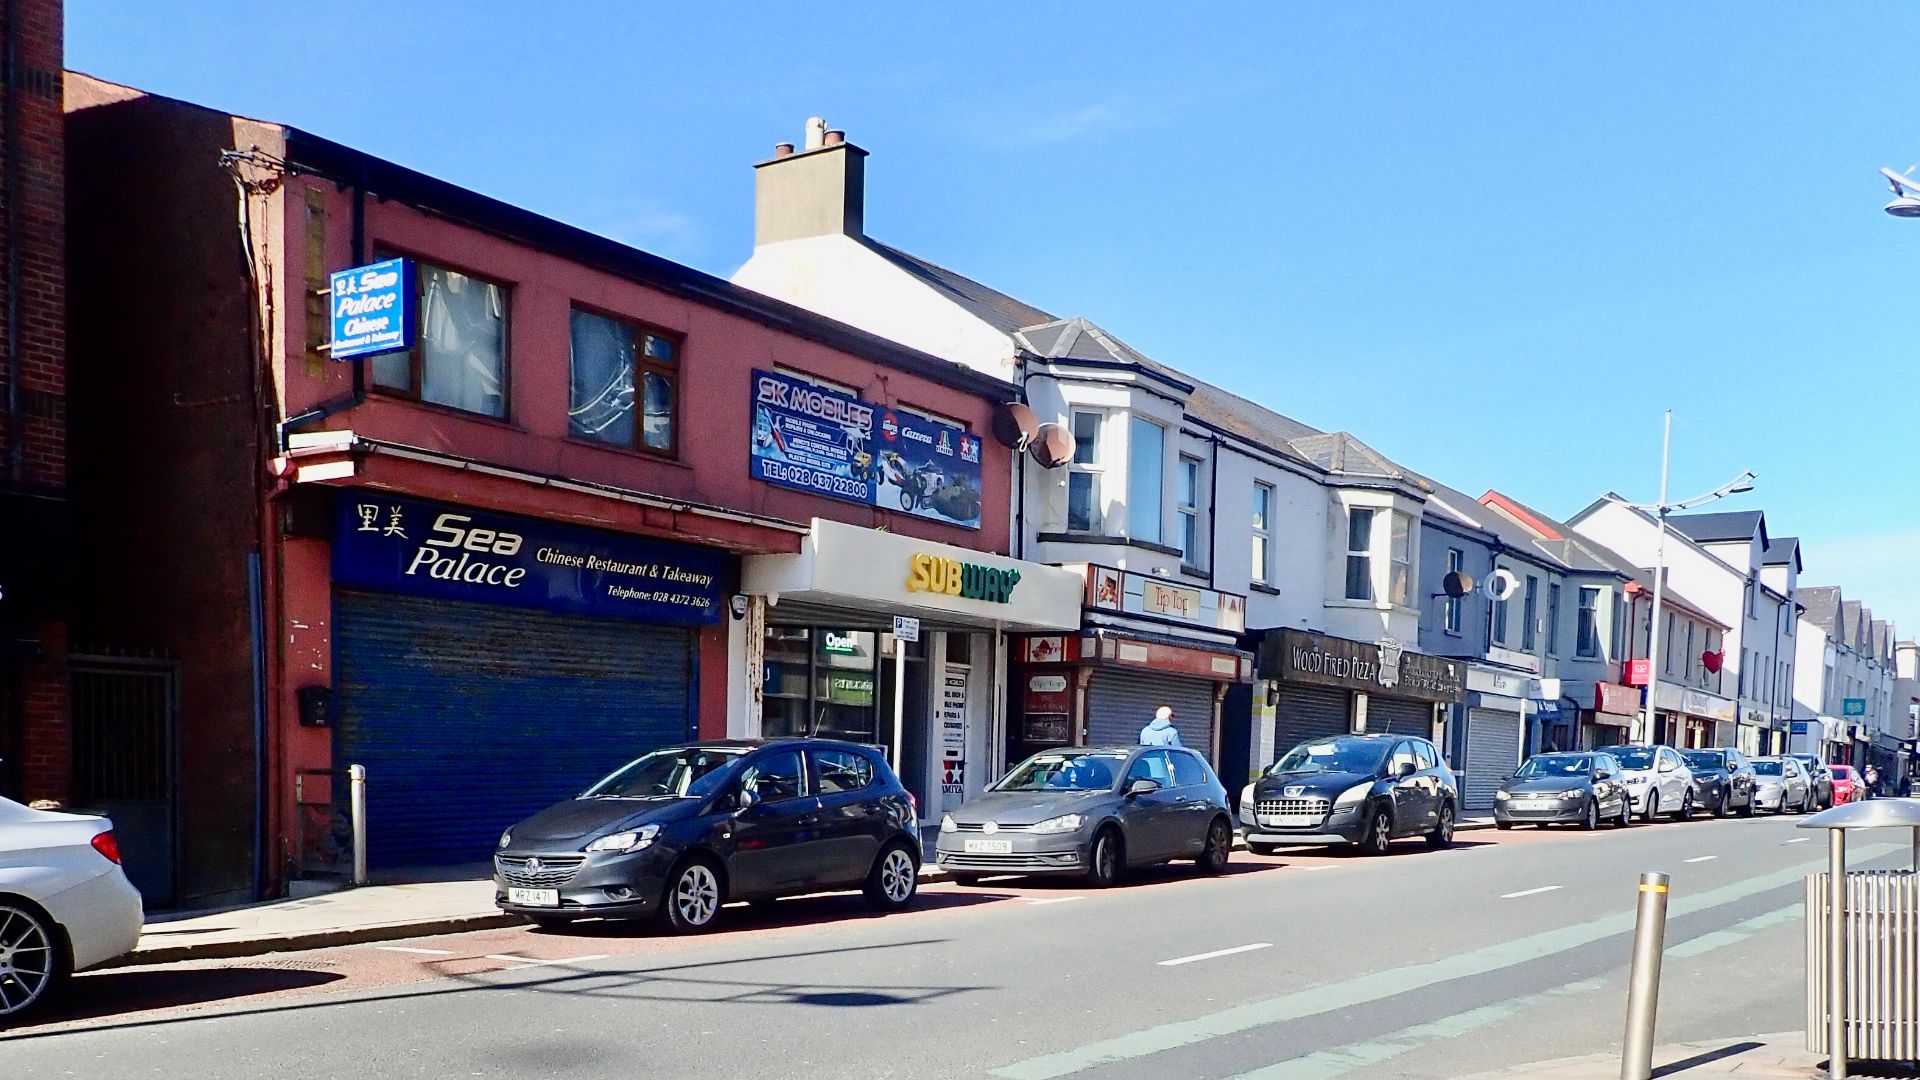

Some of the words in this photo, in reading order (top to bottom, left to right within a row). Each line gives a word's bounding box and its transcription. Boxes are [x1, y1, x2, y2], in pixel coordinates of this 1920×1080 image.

[359, 272, 398, 292] Sea
[336, 293, 396, 318] Palace
[757, 377, 789, 409] SK
[789, 386, 874, 431] MOBILES
[902, 427, 933, 444] Carrera
[426, 513, 524, 556] Sea
[405, 547, 526, 588] Palace
[536, 547, 584, 568] Chinese
[586, 555, 648, 577] Restaurant
[649, 564, 659, 579] &
[661, 565, 713, 590] Takeaway
[905, 553, 1021, 604] SUBWAY
[608, 585, 651, 602] Telephone:
[653, 591, 669, 603] 028
[670, 594, 690, 605] 4372
[691, 597, 710, 608] 3626
[1155, 585, 1170, 613] Tip
[826, 632, 853, 649] Open
[1293, 646, 1321, 672] WOOD
[1323, 652, 1350, 678] FIRED
[1352, 656, 1376, 680] PIZZA
